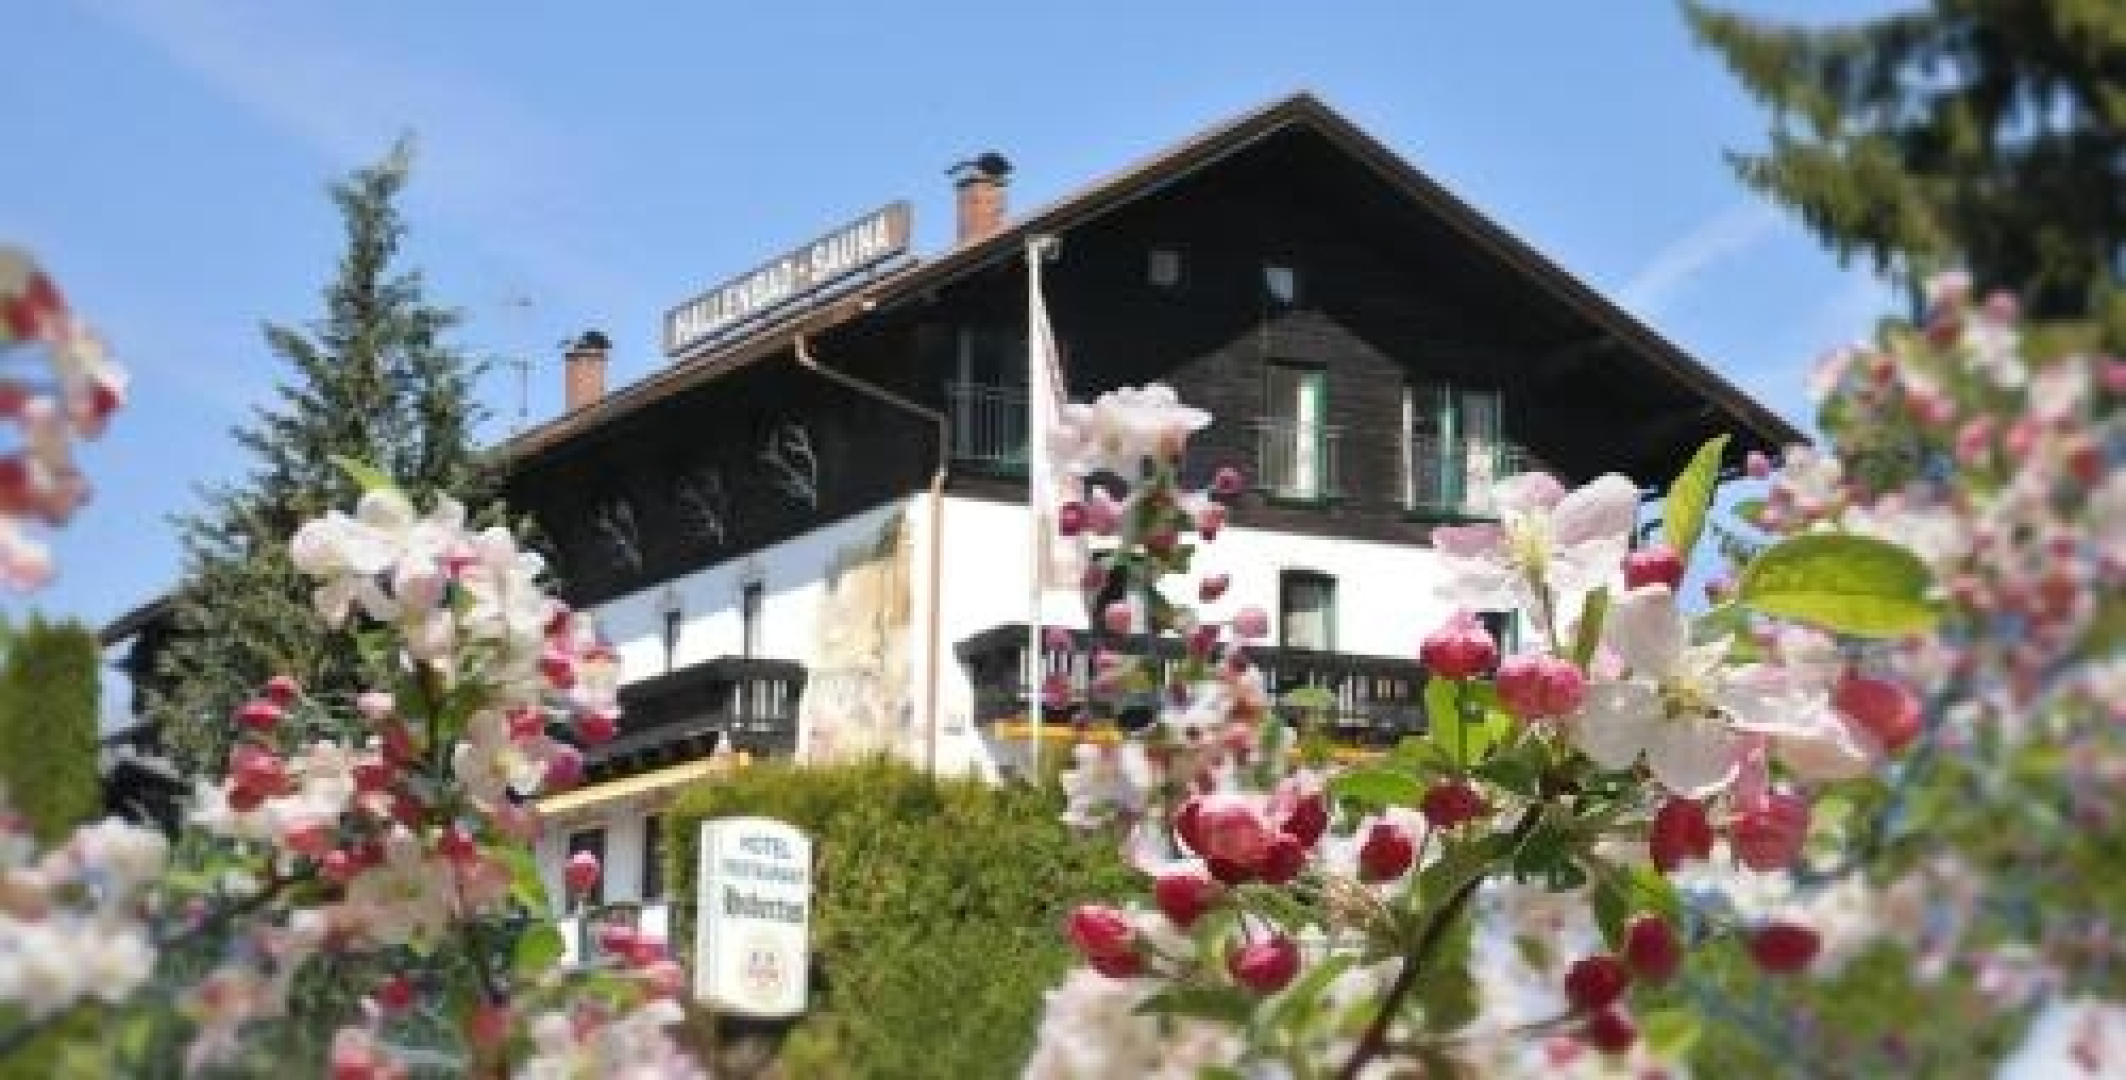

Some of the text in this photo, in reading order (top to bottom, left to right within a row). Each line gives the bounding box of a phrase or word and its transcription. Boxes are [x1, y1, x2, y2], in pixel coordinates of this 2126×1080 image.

[673, 260, 795, 347] HALLENBAD
[809, 216, 889, 284] SAUNA
[739, 834, 793, 860] HOTEL
